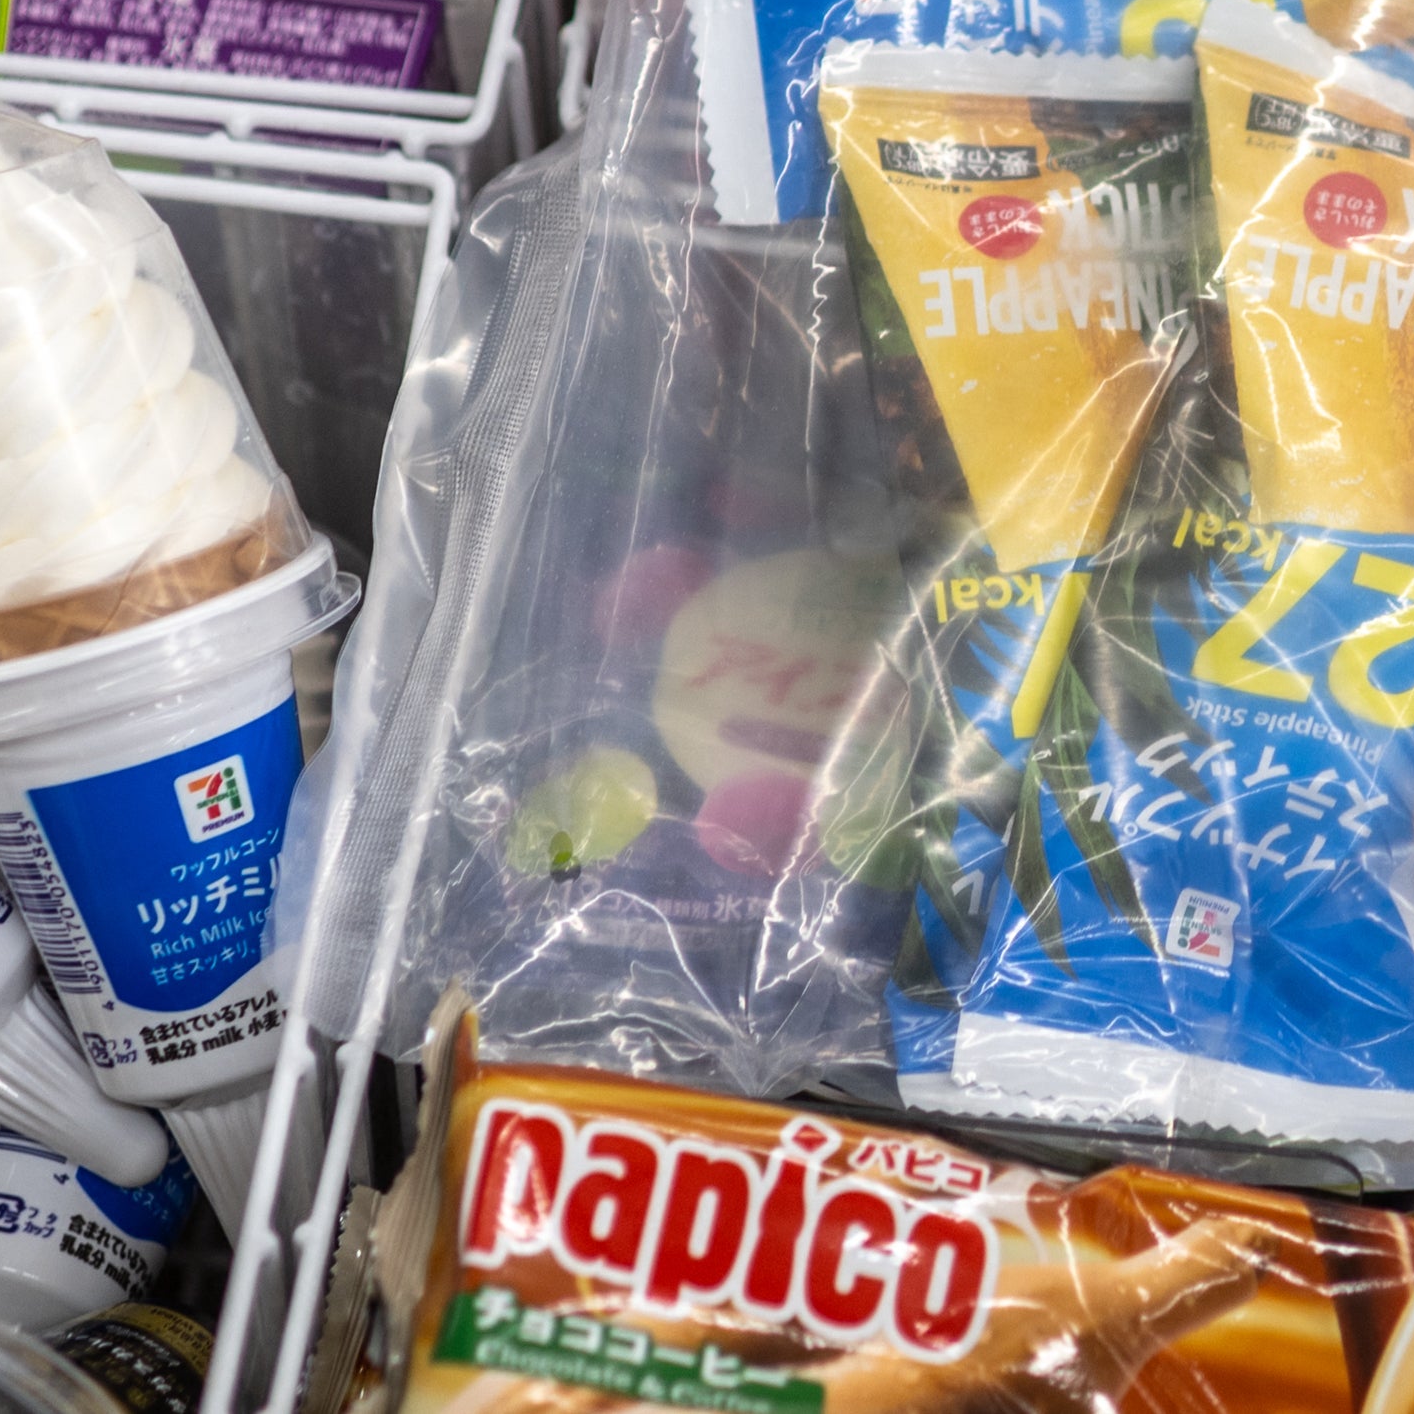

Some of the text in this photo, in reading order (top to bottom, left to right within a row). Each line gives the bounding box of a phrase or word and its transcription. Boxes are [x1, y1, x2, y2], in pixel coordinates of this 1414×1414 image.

[1312, 208, 1376, 232] おいしさ
[1317, 190, 1379, 214] そのまま
[1172, 506, 1282, 571] kcal
[936, 571, 1046, 623] kcal
[1184, 696, 1382, 768] Pineapple Stick
[1135, 731, 1389, 837] スティック
[199, 810, 247, 833] PREMIUM
[1079, 780, 1353, 891] イナップル
[18, 815, 67, 902] 054823
[165, 825, 286, 885] ワッフルコーン
[57, 902, 106, 988] 901170
[149, 931, 197, 961] Rich
[198, 914, 246, 944] Milk
[144, 1007, 282, 1068] 乳成分 milk 小麦
[852, 1139, 991, 1194] パピコ
[56, 1232, 109, 1270] 乳成分
[462, 1099, 999, 1364] papico
[473, 1288, 789, 1387] チョココーヒー
